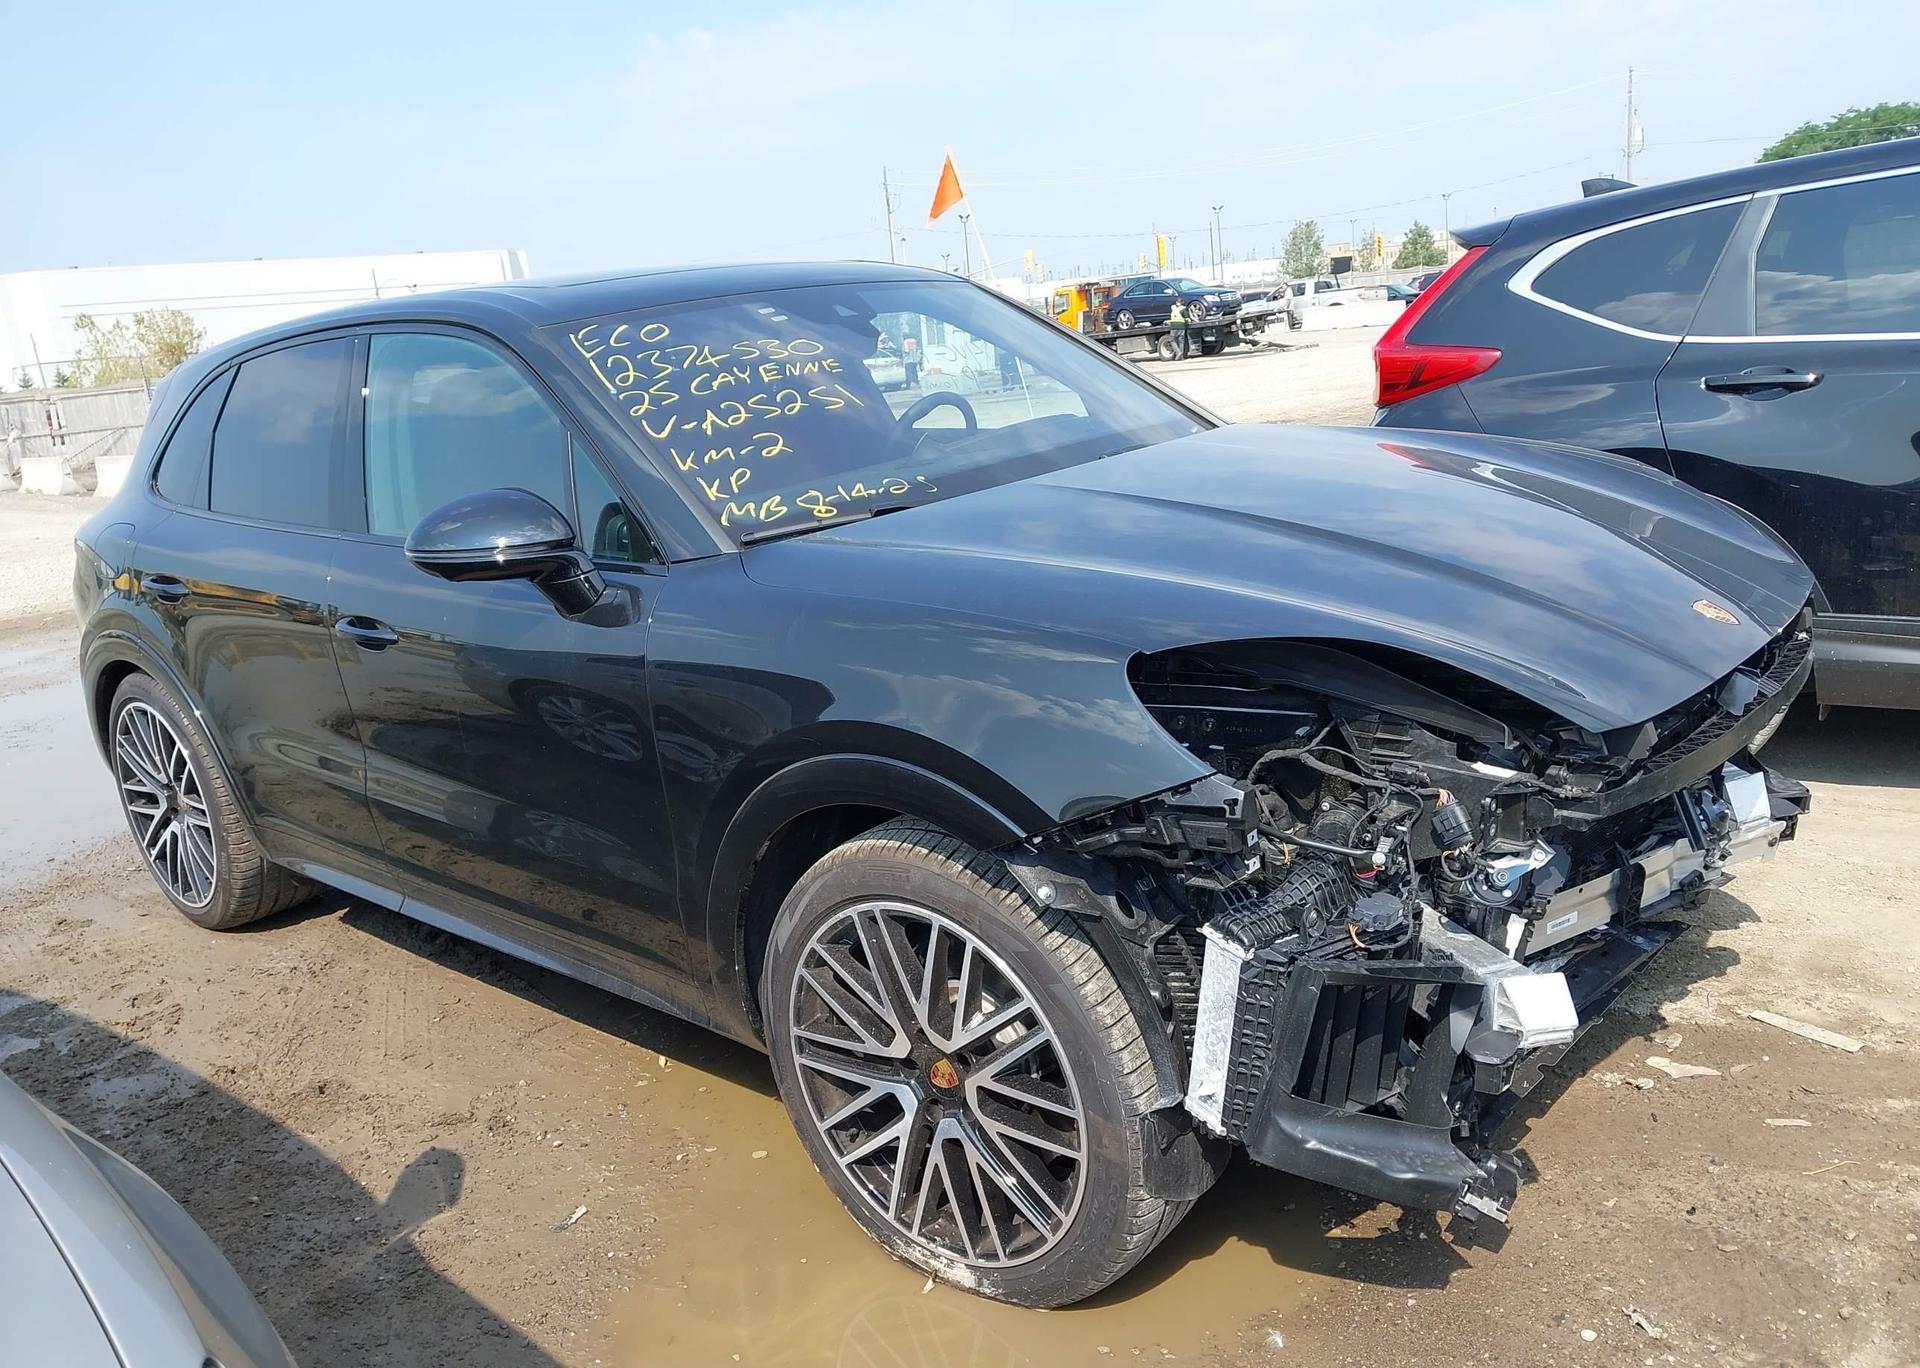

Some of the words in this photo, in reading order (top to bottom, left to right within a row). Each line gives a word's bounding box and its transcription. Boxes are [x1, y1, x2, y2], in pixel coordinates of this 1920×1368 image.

[569, 323, 670, 359] ECO
[618, 380, 680, 416] 25
[690, 358, 844, 395] CAYENNE
[696, 467, 751, 501] KP
[720, 494, 788, 527] MB
